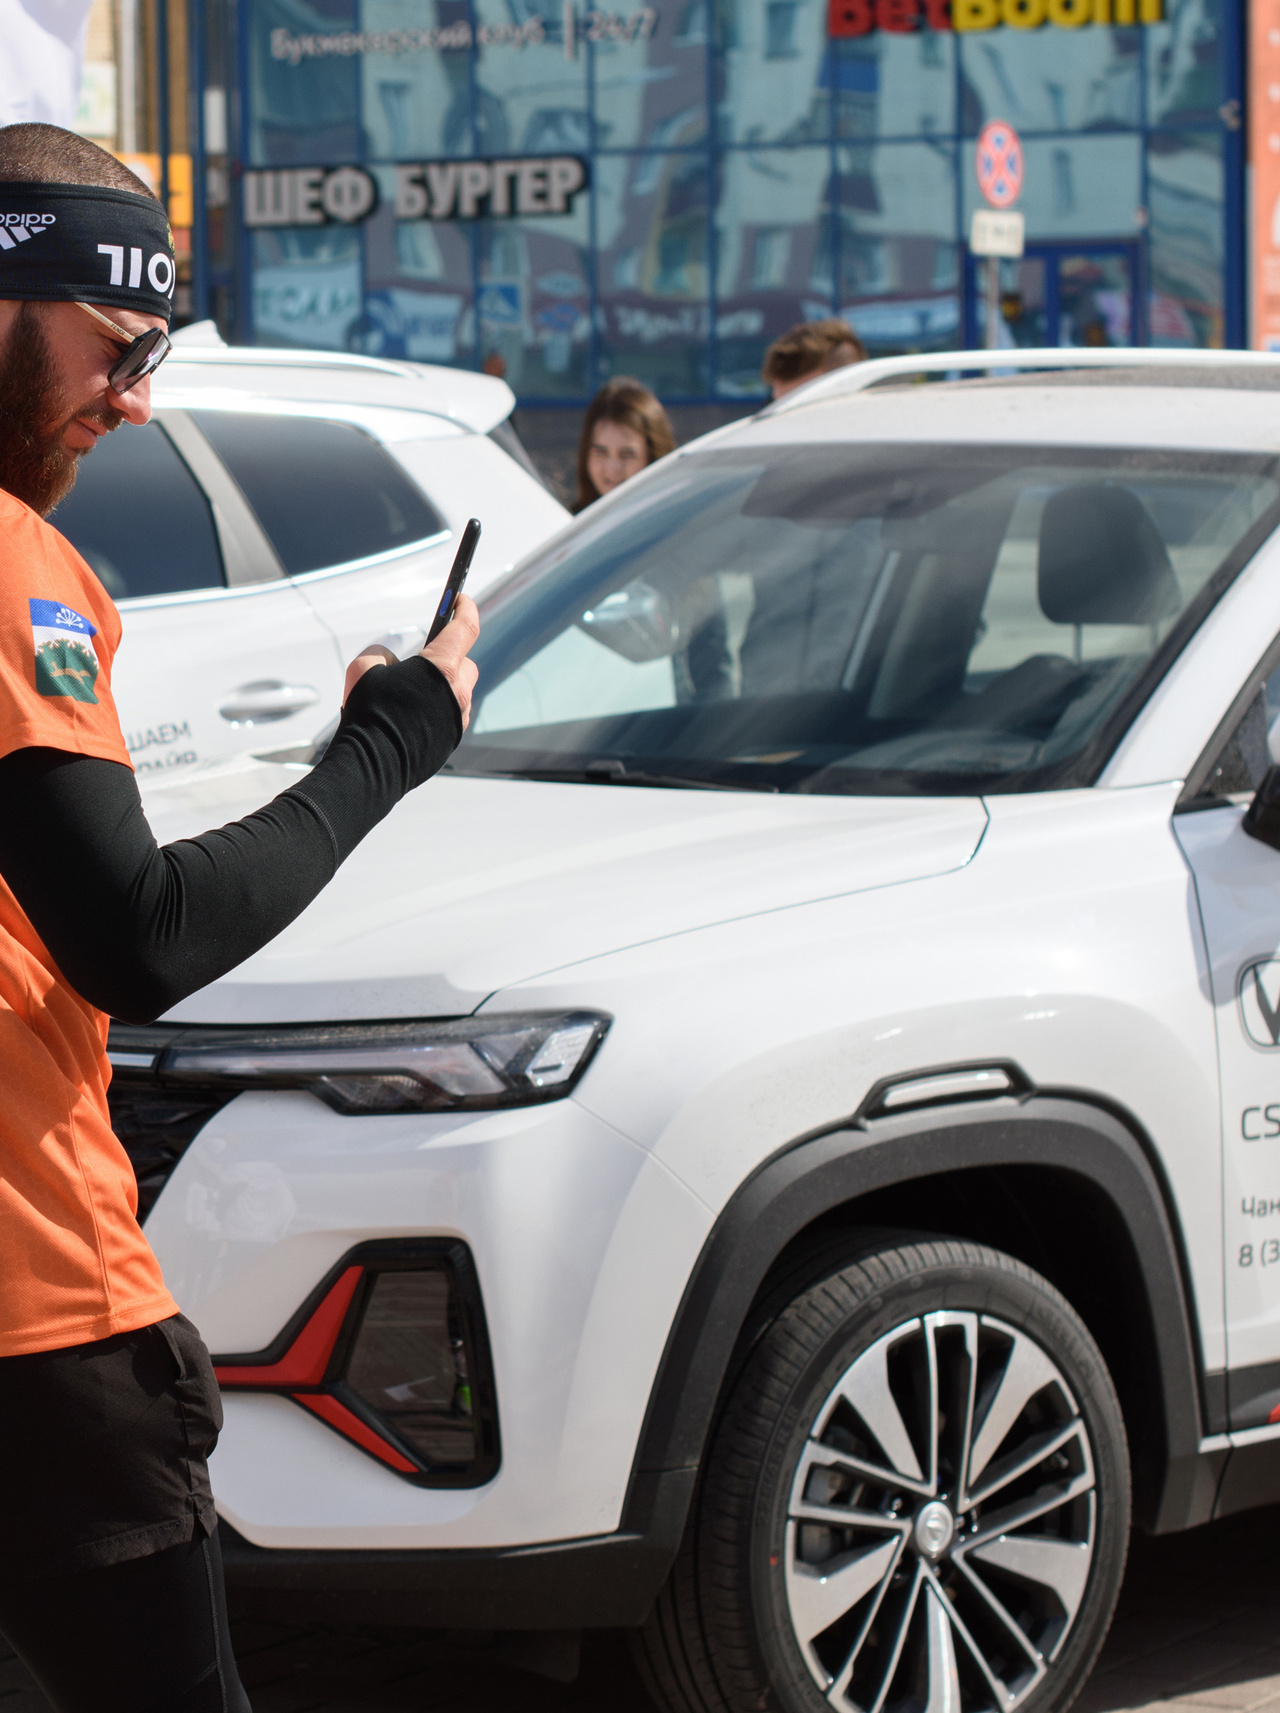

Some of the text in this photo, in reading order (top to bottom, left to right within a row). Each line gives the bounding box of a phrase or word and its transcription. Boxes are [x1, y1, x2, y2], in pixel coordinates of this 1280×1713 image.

[244, 157, 585, 225] ШЕФ БУРГЕР
[97, 243, 176, 299] OIL
[1239, 1243, 1254, 1268] 8
